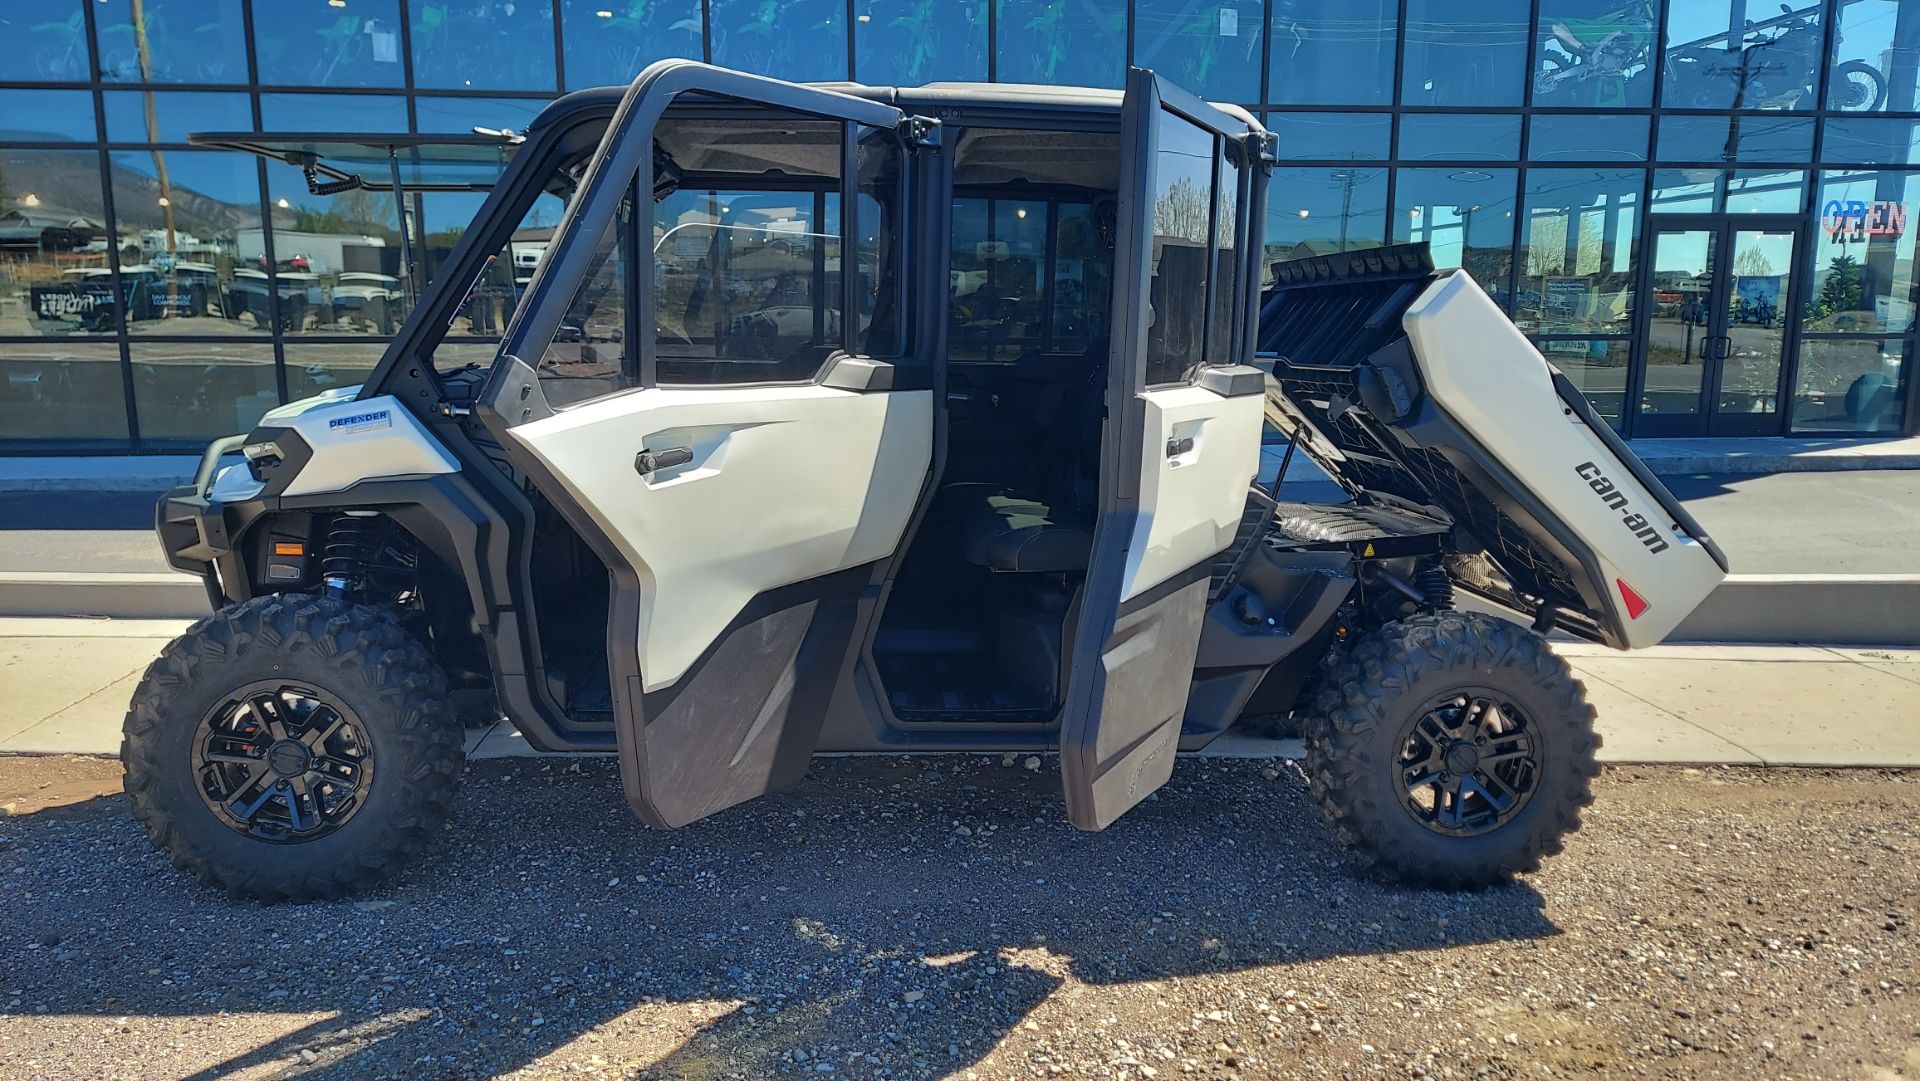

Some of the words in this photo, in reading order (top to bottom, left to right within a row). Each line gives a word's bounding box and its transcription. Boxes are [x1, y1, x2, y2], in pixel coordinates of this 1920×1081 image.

[1822, 200, 1908, 234] OPEN
[329, 411, 387, 428] DEFENDER
[1574, 461, 1669, 554] can-am
